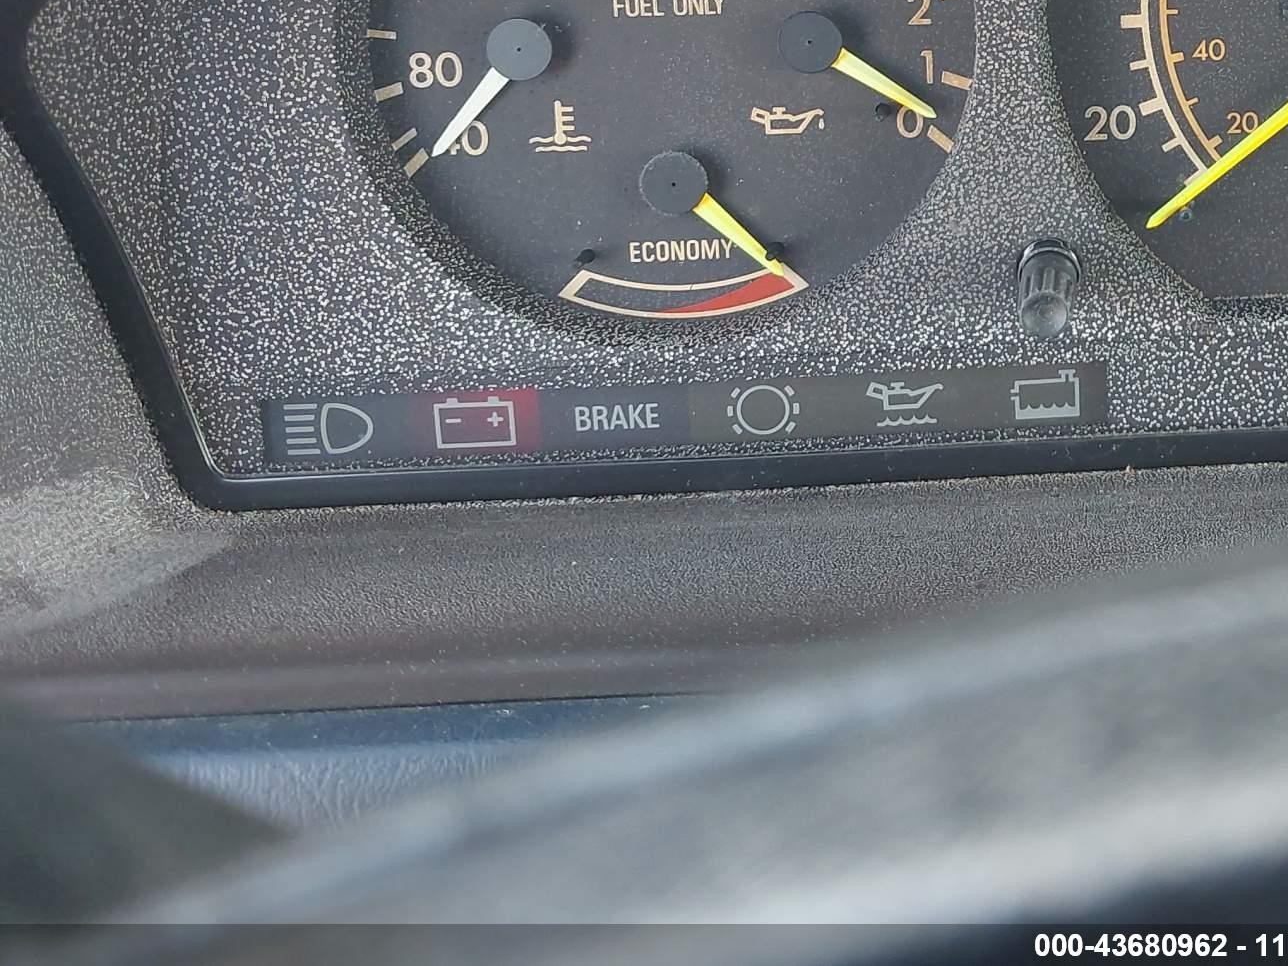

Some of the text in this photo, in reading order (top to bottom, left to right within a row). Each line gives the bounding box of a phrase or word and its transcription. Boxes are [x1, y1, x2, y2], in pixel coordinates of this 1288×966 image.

[1192, 39, 1226, 61] 40
[408, 51, 464, 90] 80
[919, 49, 934, 85] 1
[896, 105, 924, 139] 0
[1083, 105, 1137, 142] 20
[1226, 112, 1260, 135] 20
[628, 239, 734, 264] ECONOMY
[574, 403, 660, 431] BRAKE
